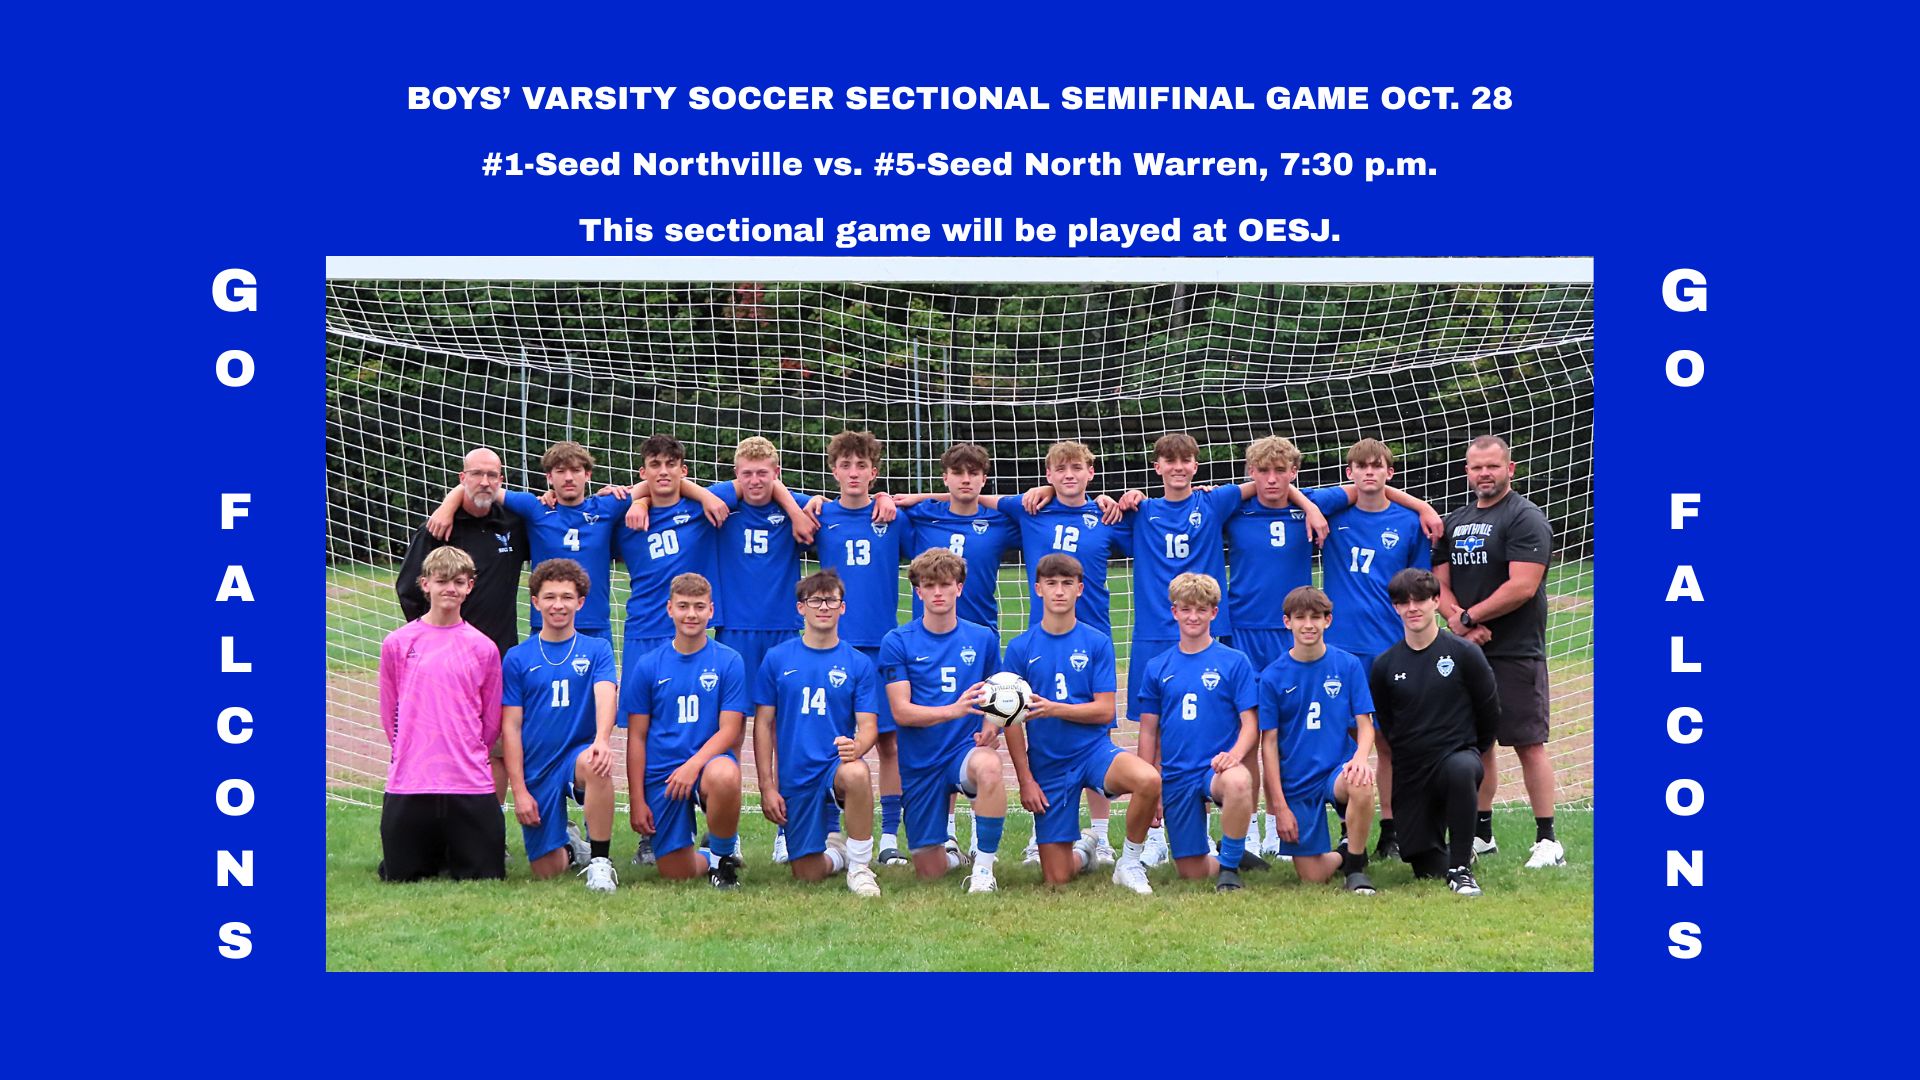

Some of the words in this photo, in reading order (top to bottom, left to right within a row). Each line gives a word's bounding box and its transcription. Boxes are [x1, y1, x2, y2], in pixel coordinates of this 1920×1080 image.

[563, 529, 580, 551] 4
[648, 530, 680, 560] 20
[744, 529, 769, 554] 15
[949, 533, 966, 557] 8
[1053, 524, 1080, 553] 12
[1164, 533, 1190, 559] 16
[1269, 521, 1286, 547] 9
[845, 539, 871, 566] 13
[1349, 546, 1376, 574] 17
[1451, 551, 1488, 565] SOCCER
[551, 679, 570, 708] 11
[940, 666, 957, 693] 5
[1055, 672, 1068, 701] 3
[677, 695, 700, 724] 10
[801, 687, 827, 716] 14
[1181, 692, 1198, 721] 6
[1306, 702, 1322, 730] 2
